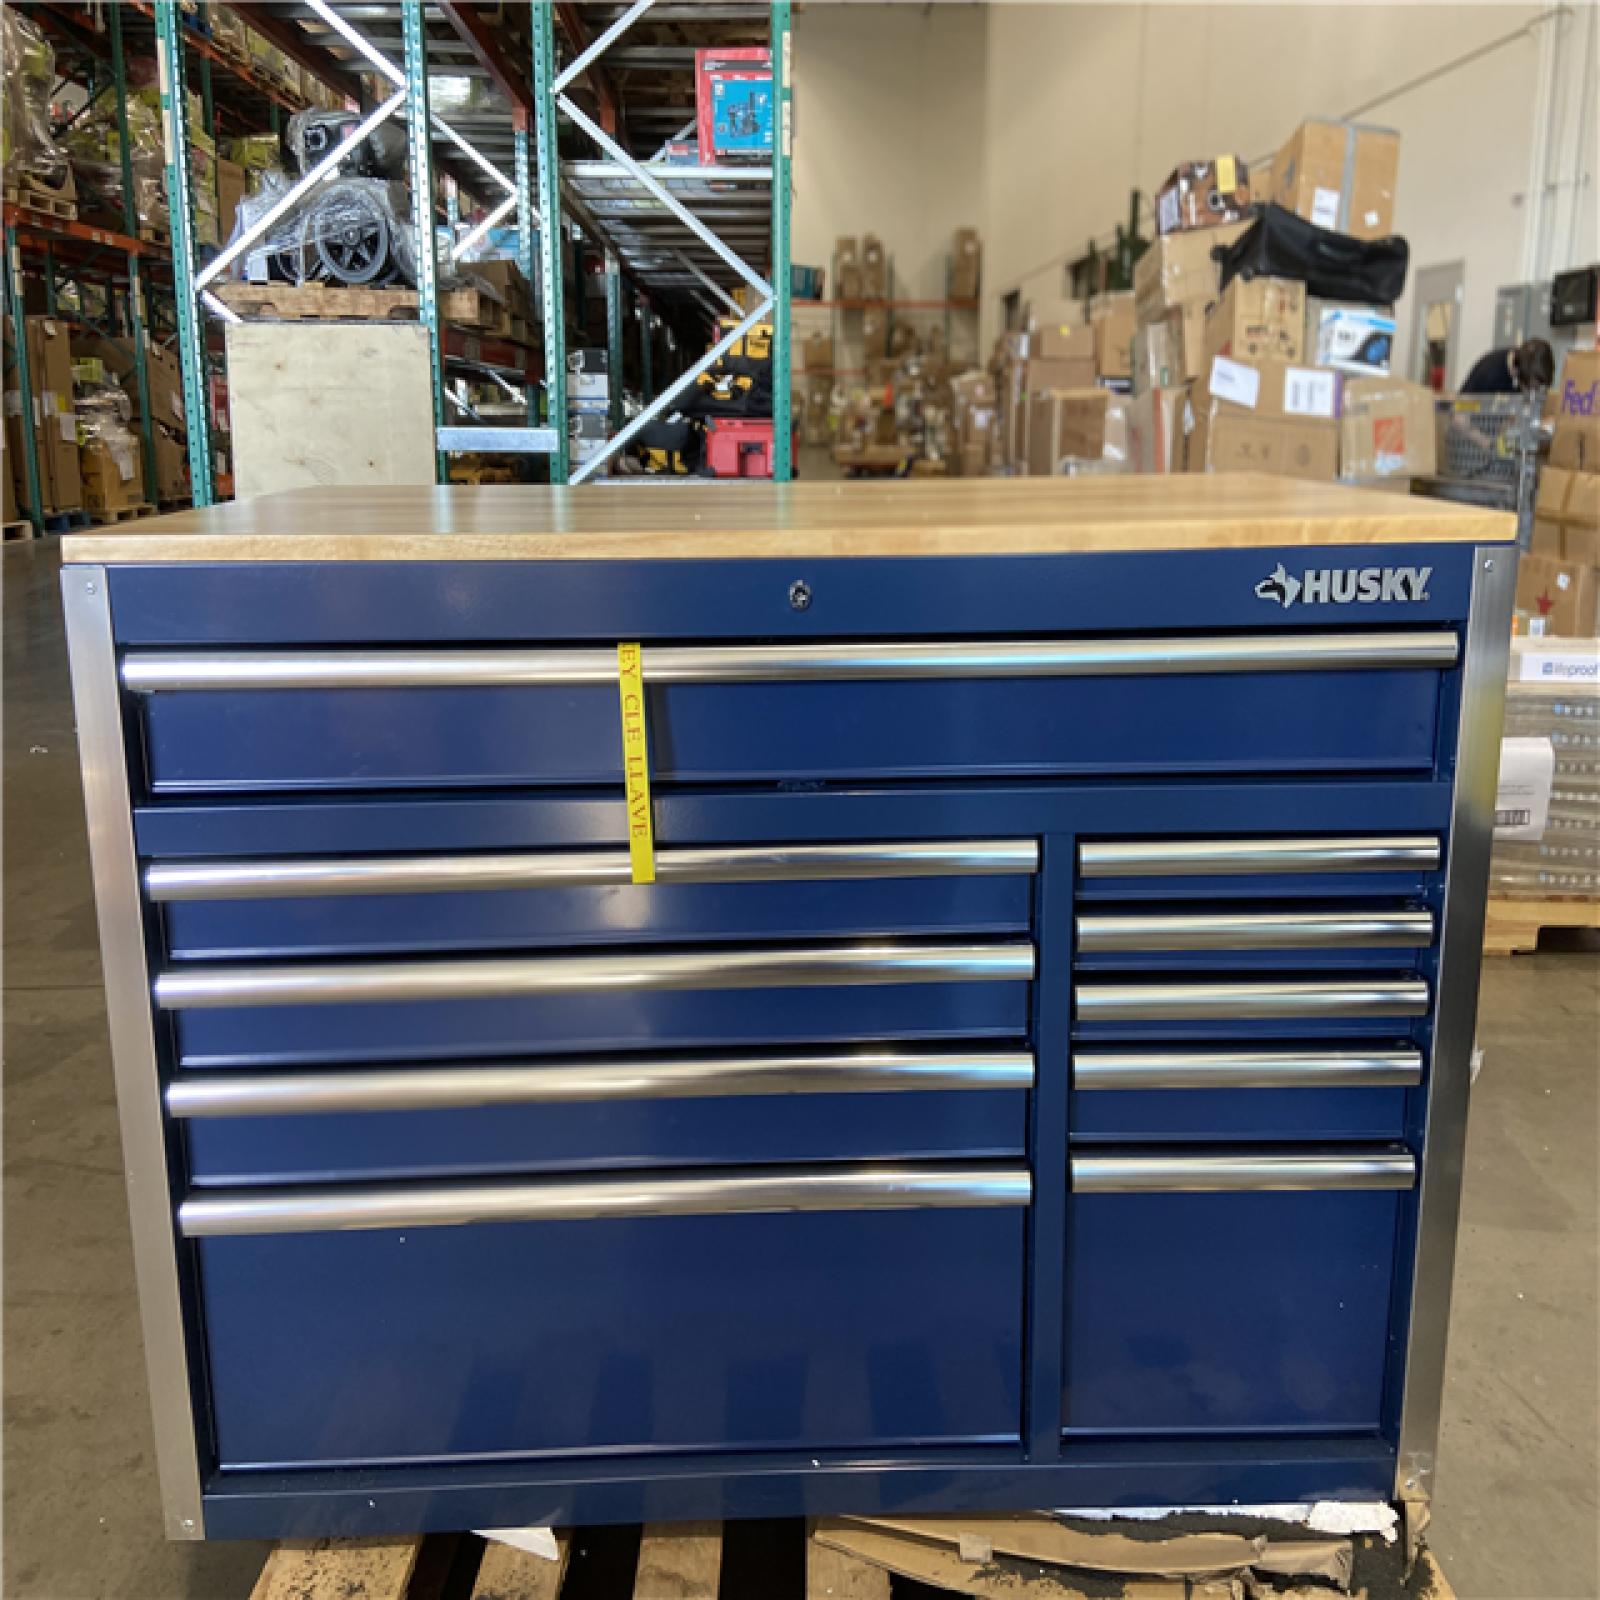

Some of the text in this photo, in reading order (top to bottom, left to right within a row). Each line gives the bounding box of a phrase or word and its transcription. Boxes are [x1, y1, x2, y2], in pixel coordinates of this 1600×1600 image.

[1562, 379, 1598, 416] Fed
[1303, 567, 1431, 603] HUSKY
[621, 645, 648, 838] EY CLE LLAVE
